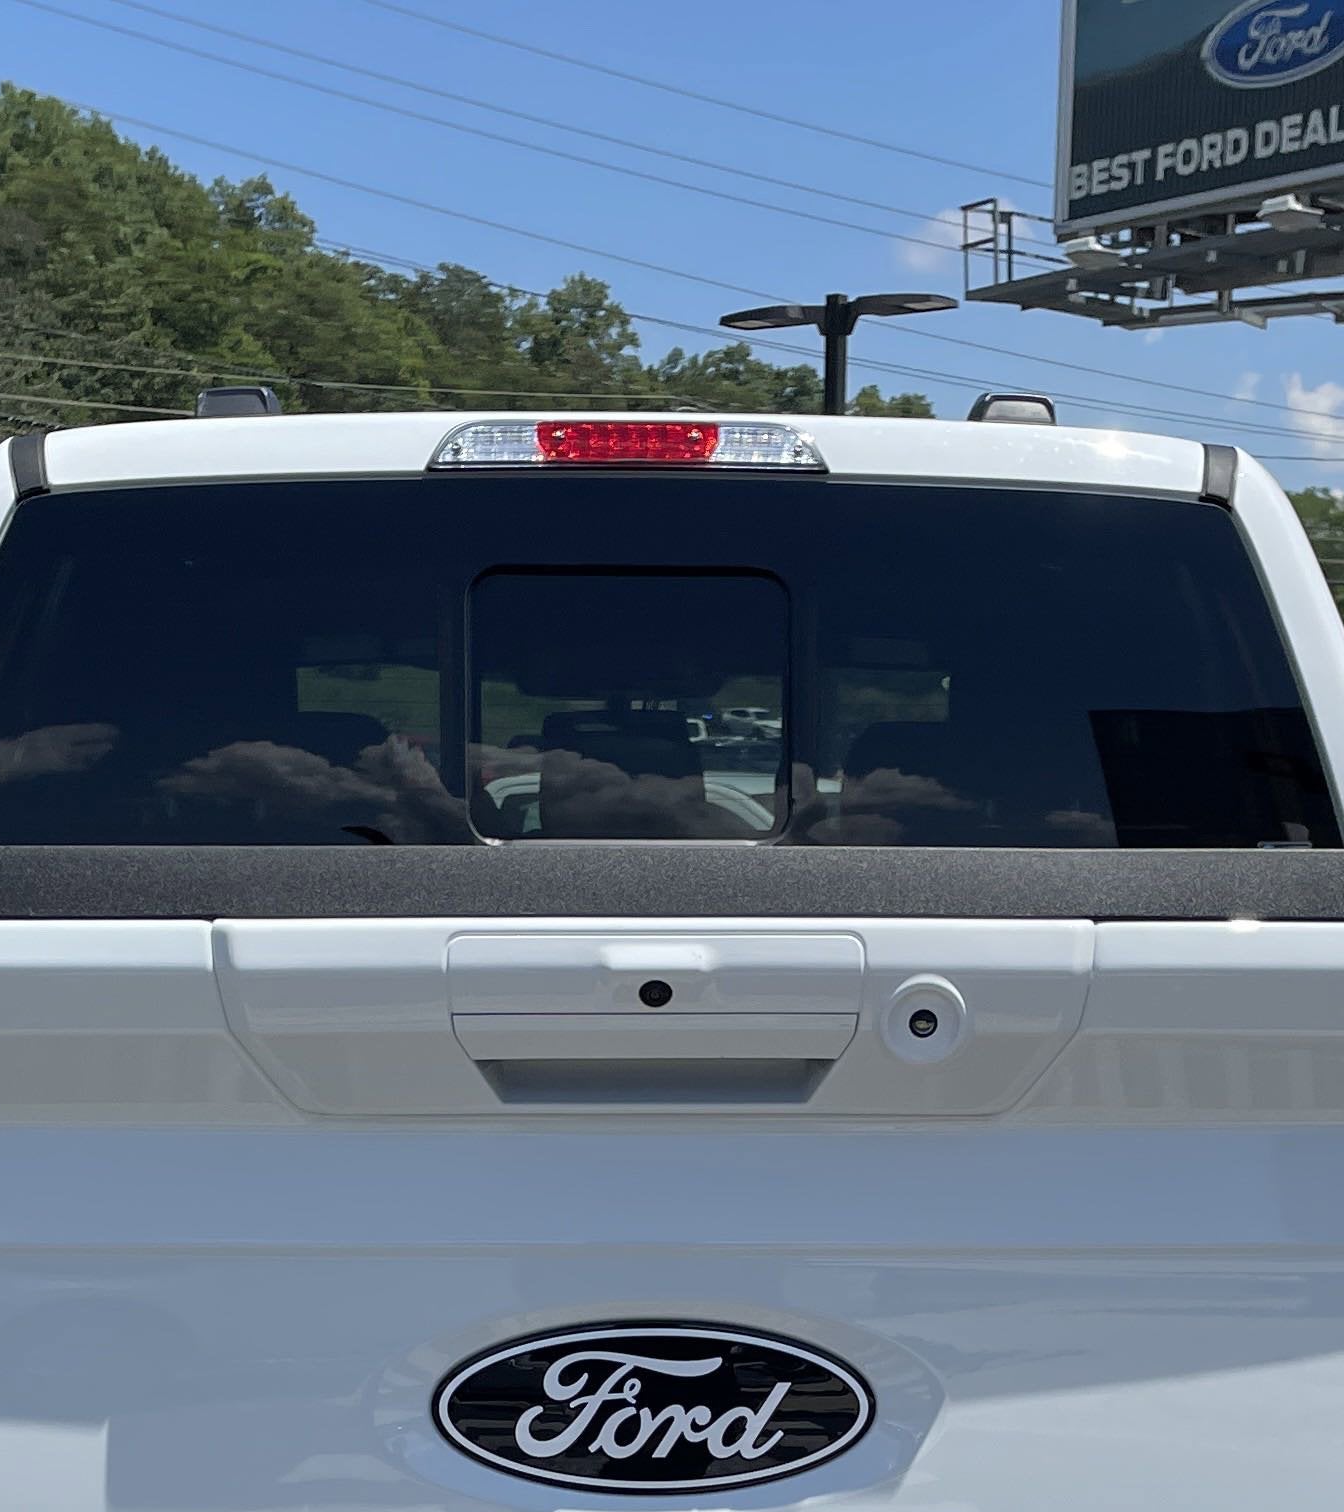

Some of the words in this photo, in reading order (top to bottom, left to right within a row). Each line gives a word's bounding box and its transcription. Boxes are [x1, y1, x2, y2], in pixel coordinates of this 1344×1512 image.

[1237, 3, 1335, 71] Ford
[1070, 149, 1152, 200] BEST
[1155, 128, 1249, 182] FORD
[514, 1350, 792, 1460] Ford
